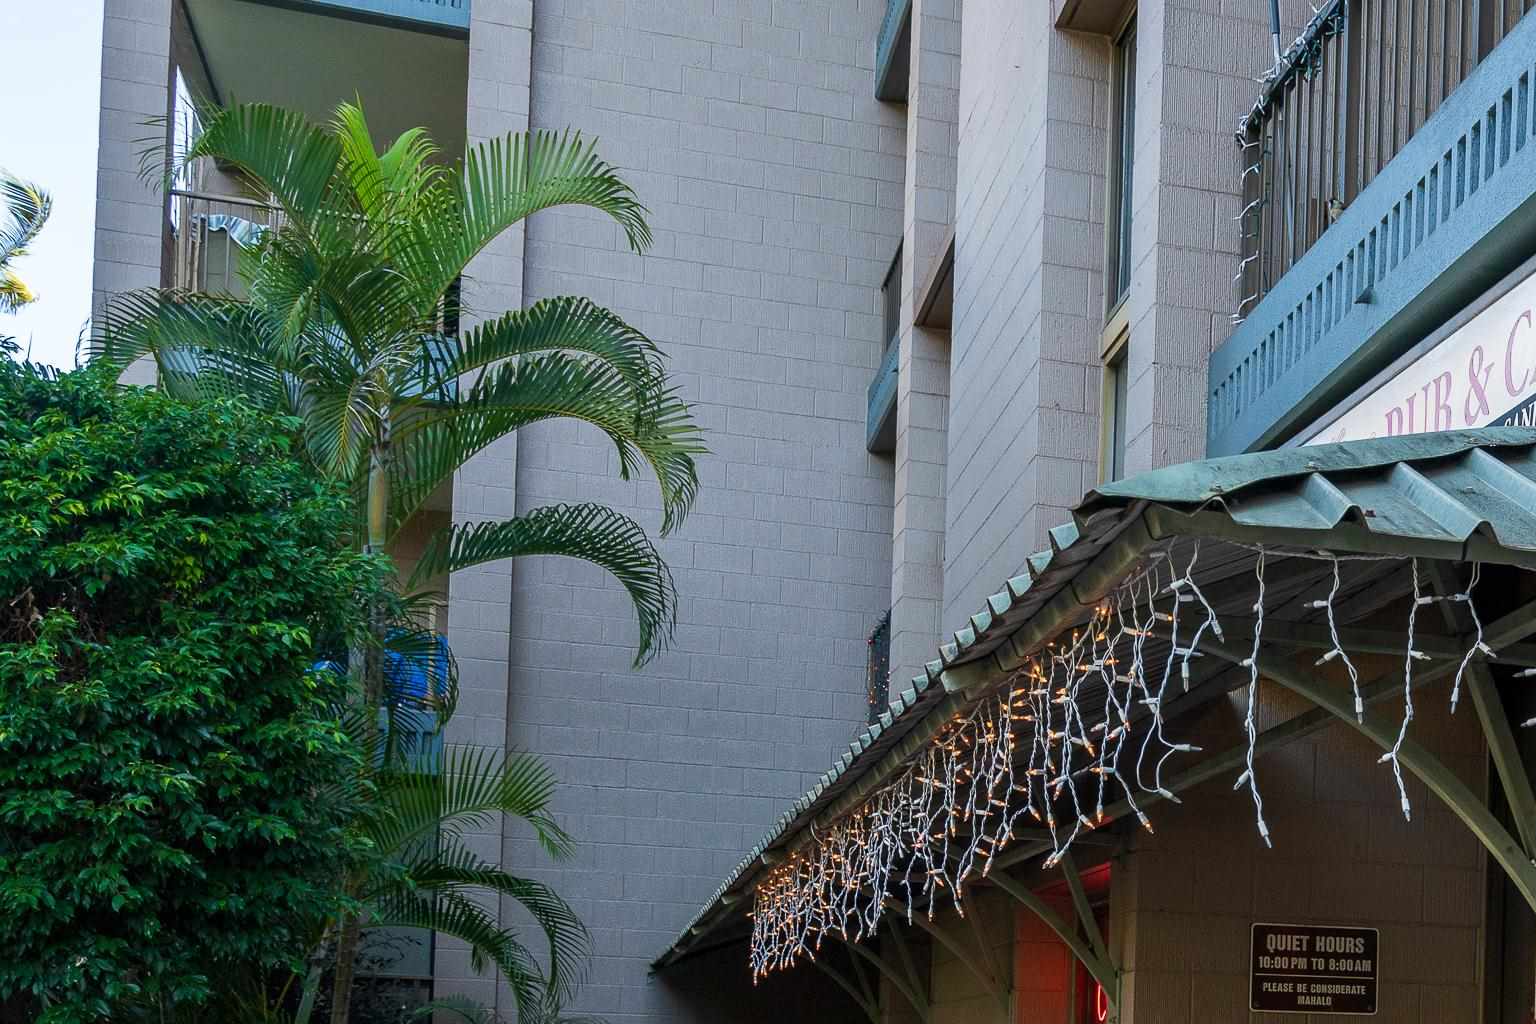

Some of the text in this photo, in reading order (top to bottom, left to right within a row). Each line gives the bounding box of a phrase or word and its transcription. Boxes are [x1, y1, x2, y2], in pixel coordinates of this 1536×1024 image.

[1464, 345, 1495, 426] &
[1266, 933, 1365, 953] QUIET HOURS
[1258, 956, 1289, 969] 10:00
[1291, 957, 1307, 969] PM
[1311, 958, 1325, 970] TO
[1262, 982, 1293, 993] PLEASE
[1310, 984, 1366, 995] CONSIDERATE
[1297, 996, 1332, 1006] MAHALO
